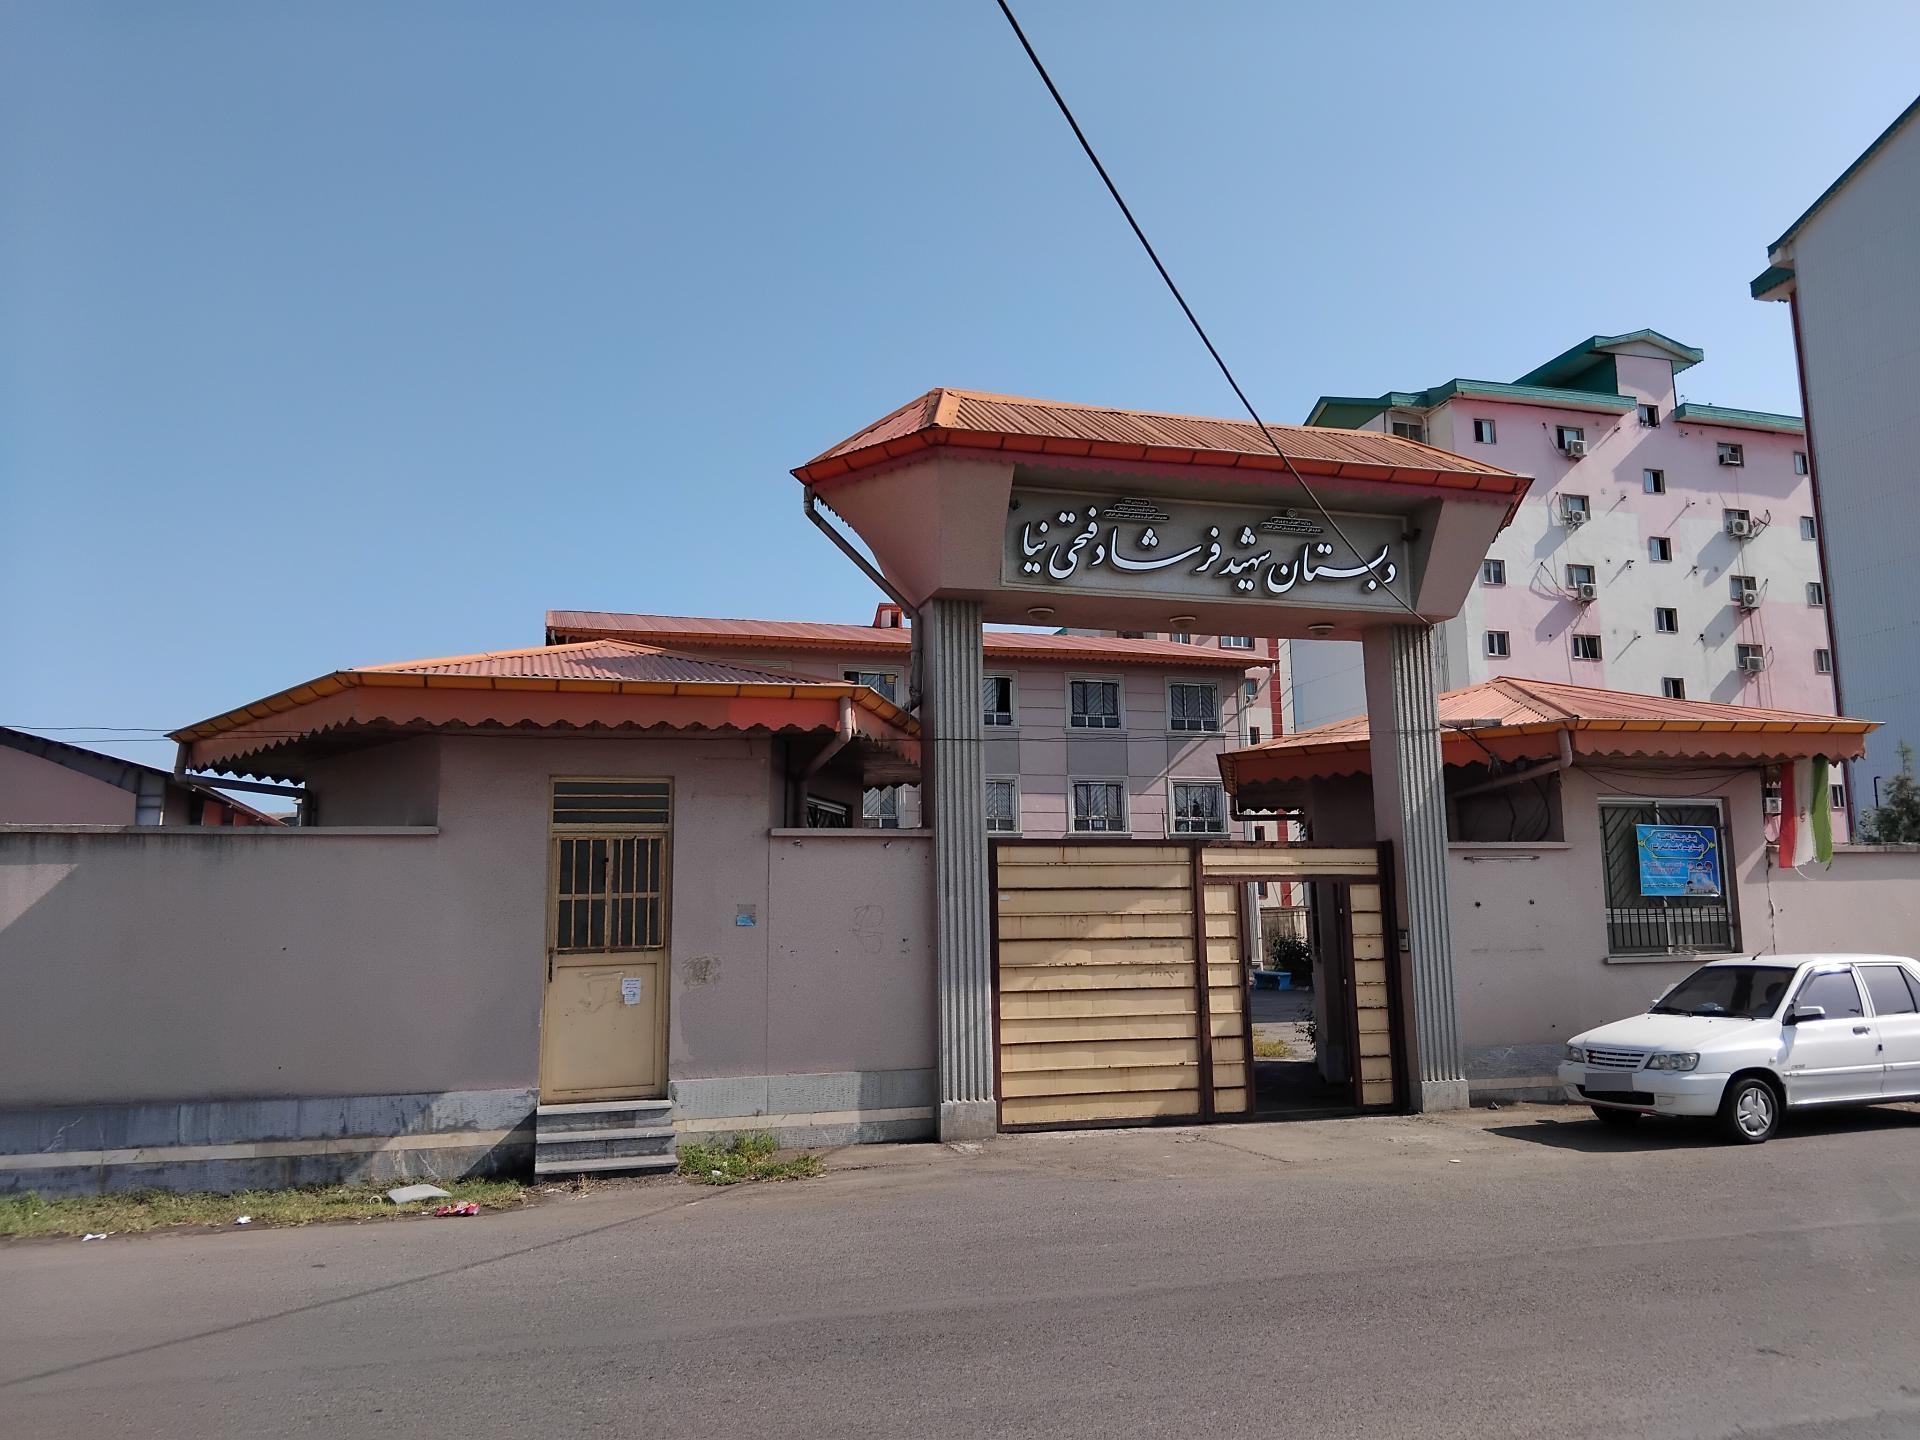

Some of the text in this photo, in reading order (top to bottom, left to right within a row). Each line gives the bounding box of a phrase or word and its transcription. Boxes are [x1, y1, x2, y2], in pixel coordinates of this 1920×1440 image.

[1022, 507, 1396, 593] دبستان شهید فرشاد فتحی نیا
